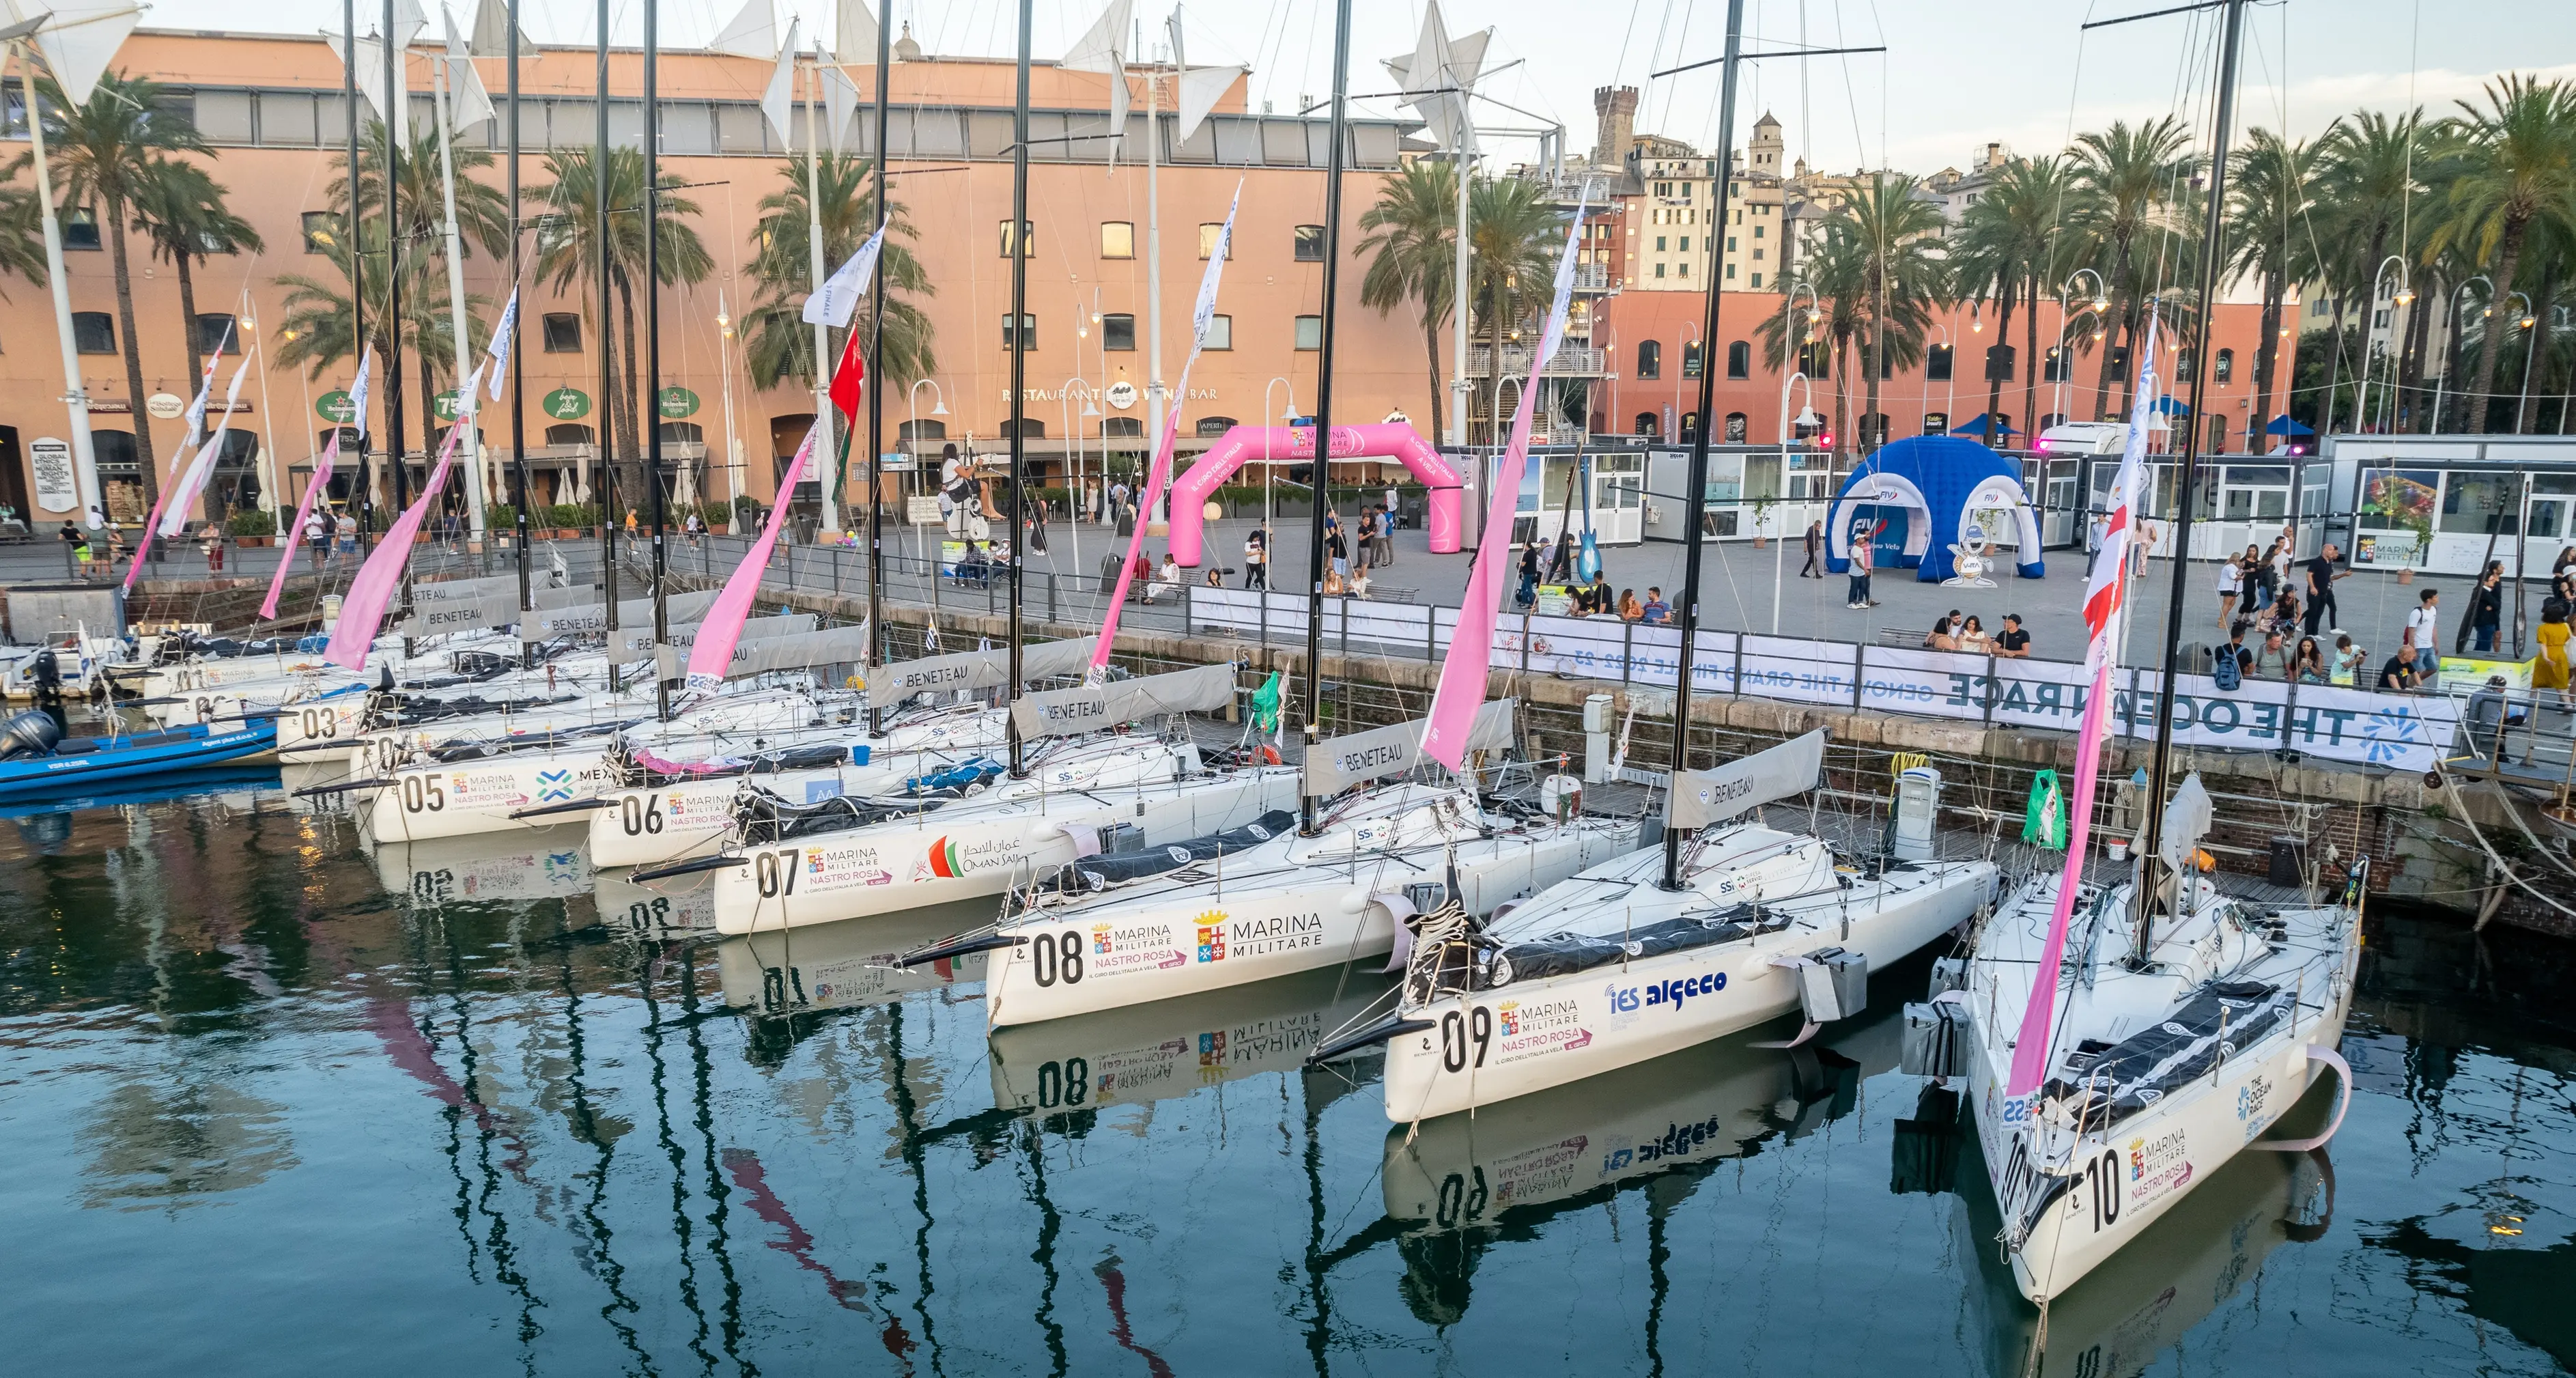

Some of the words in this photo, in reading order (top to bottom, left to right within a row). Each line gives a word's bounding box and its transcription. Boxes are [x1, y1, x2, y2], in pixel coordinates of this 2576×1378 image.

[1002, 388, 1101, 402] RSTAURANT
[1190, 389, 1217, 400] BAR
[1415, 439, 1429, 456] GIRO
[1198, 467, 1213, 486] GIRO
[1218, 463, 1235, 480] VELA
[1422, 461, 1436, 476] VELA
[1880, 491, 1893, 500] FIV
[1852, 518, 1879, 535] FIV
[429, 608, 482, 625] BENETEAU
[552, 617, 608, 632] BENETEAU
[906, 665, 969, 688] BENETEAU
[1048, 699, 1105, 720] BENETEAU
[302, 707, 336, 740] 03
[1344, 742, 1403, 773] BENETEAU
[470, 774, 515, 785] MARINA
[1058, 772, 1073, 782] SSi
[404, 773, 444, 813] 05
[455, 793, 492, 804] NASTRO
[494, 792, 518, 802] ROSA
[1713, 774, 1754, 806] BENETEAU
[686, 795, 731, 806] MARINA
[622, 793, 663, 836] 06
[670, 815, 709, 826] NASTRO
[1358, 829, 1374, 840] SSi
[827, 847, 878, 862] MARINA
[827, 858, 879, 871] MILITARE
[963, 857, 999, 872] OMAN
[755, 848, 799, 899] 07
[810, 871, 851, 886] NASTRO
[853, 869, 880, 880] ROSA
[1720, 882, 1734, 894] SSi
[1114, 924, 1172, 942] MARINA
[1233, 912, 1323, 941] MARINA
[1115, 938, 1172, 952] MILITARE
[1233, 933, 1322, 959] MILITARE
[1033, 929, 1084, 988] 08
[1095, 952, 1141, 969] NASTRO
[1144, 949, 1174, 963] ROSA
[1109, 968, 1139, 976] DELL'ITALIA
[1646, 971, 1728, 1013] algeco
[1522, 1000, 1578, 1020] MARINA
[1523, 1015, 1579, 1032] MILITARE
[1443, 1005, 1492, 1073] 09
[1501, 1033, 1548, 1053] NASTRO
[1548, 1028, 1579, 1044] ROSA
[1514, 1052, 1545, 1062] DELL'ITALIA
[1550, 1046, 1563, 1054] VELA
[2251, 1075, 2262, 1090] THE
[2250, 1080, 2272, 1103] OCEAN
[2248, 1098, 2264, 1116] RACE
[2146, 1127, 2185, 1157] MARINA
[2146, 1144, 2185, 1173] MILITARE
[2132, 1175, 2164, 1202] NASTRO
[2164, 1162, 2185, 1185] ROSA
[2086, 1149, 2120, 1233] 10
